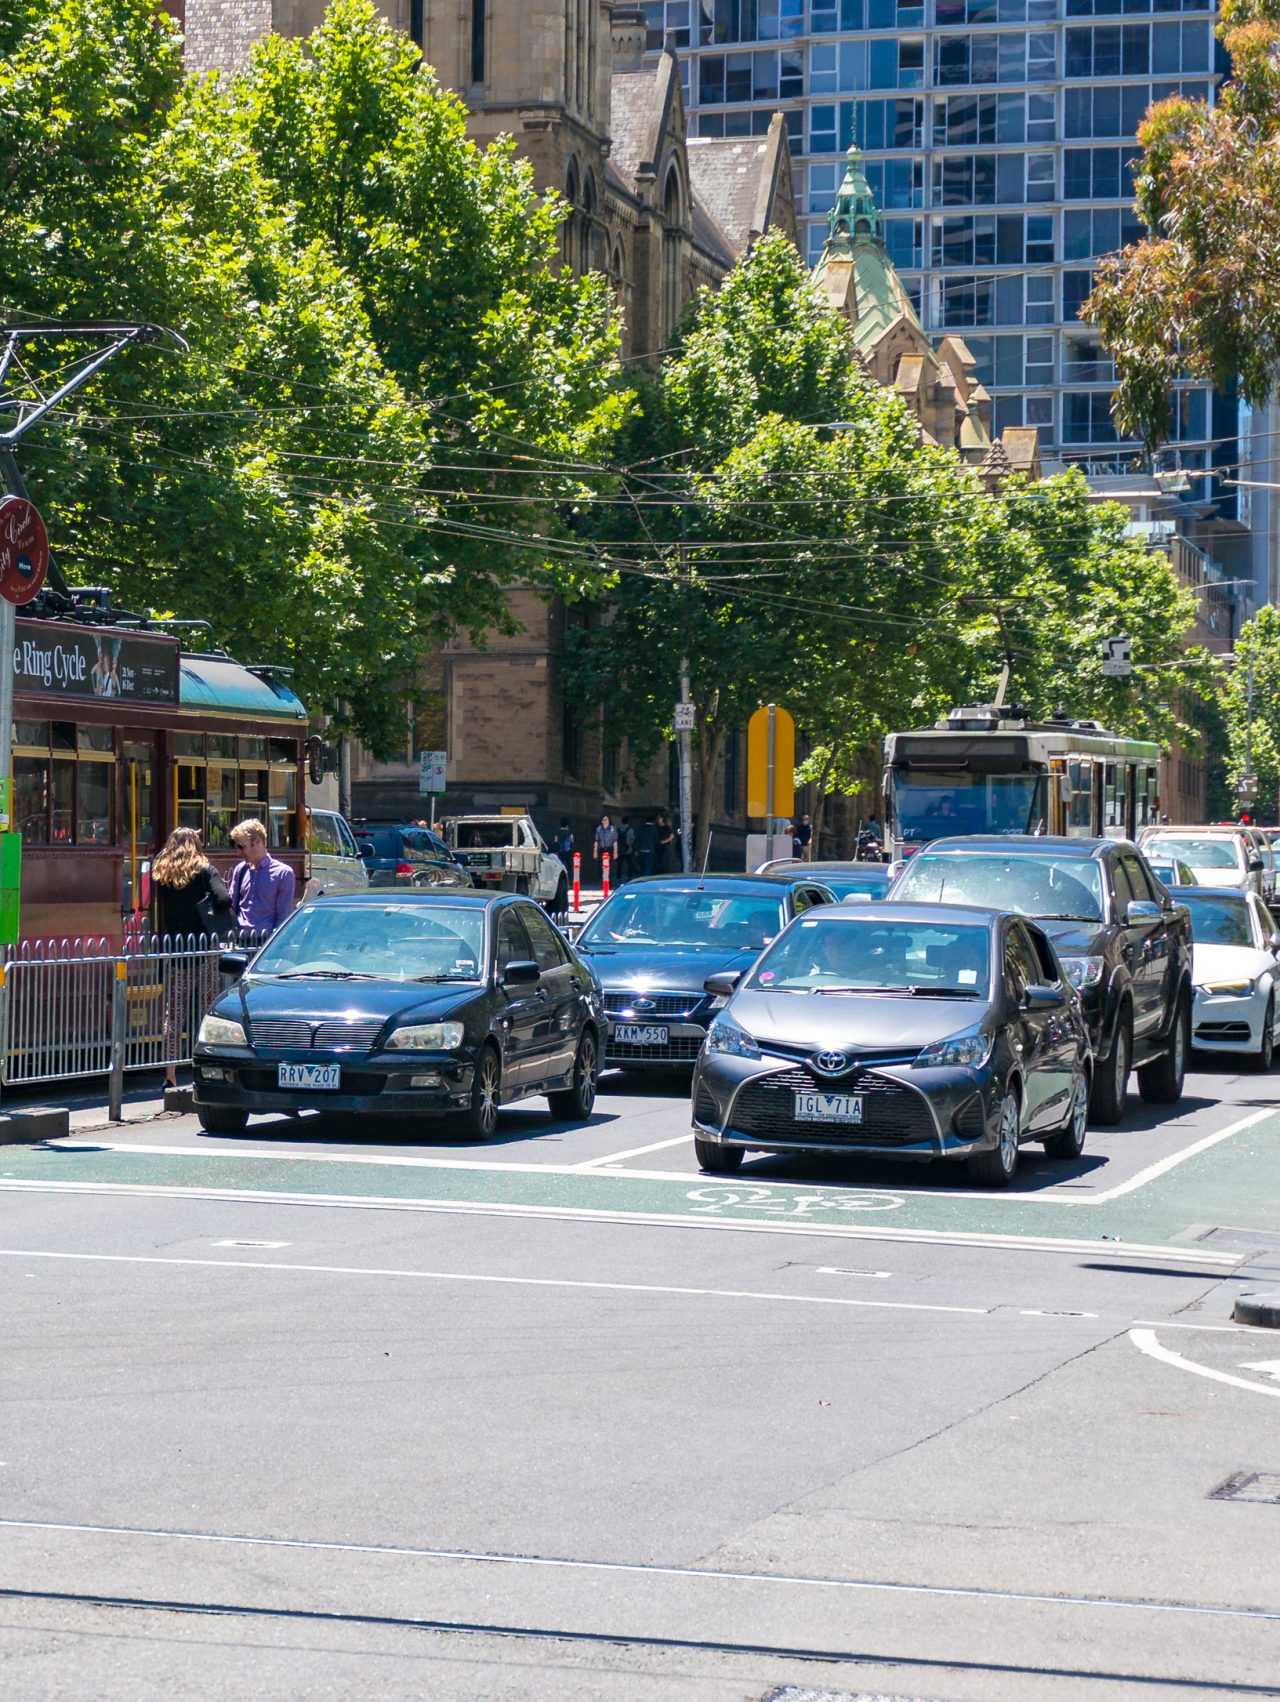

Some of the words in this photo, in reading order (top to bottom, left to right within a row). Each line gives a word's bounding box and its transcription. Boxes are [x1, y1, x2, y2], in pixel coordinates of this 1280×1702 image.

[17, 535, 35, 549] Tram
[22, 640, 52, 687] Ring
[53, 645, 87, 688] Cycle
[616, 1027, 638, 1039] XKM
[646, 1028, 667, 1041] 550
[280, 1067, 304, 1082] RRV
[314, 1069, 337, 1083] 207
[799, 1097, 822, 1113] 1GL
